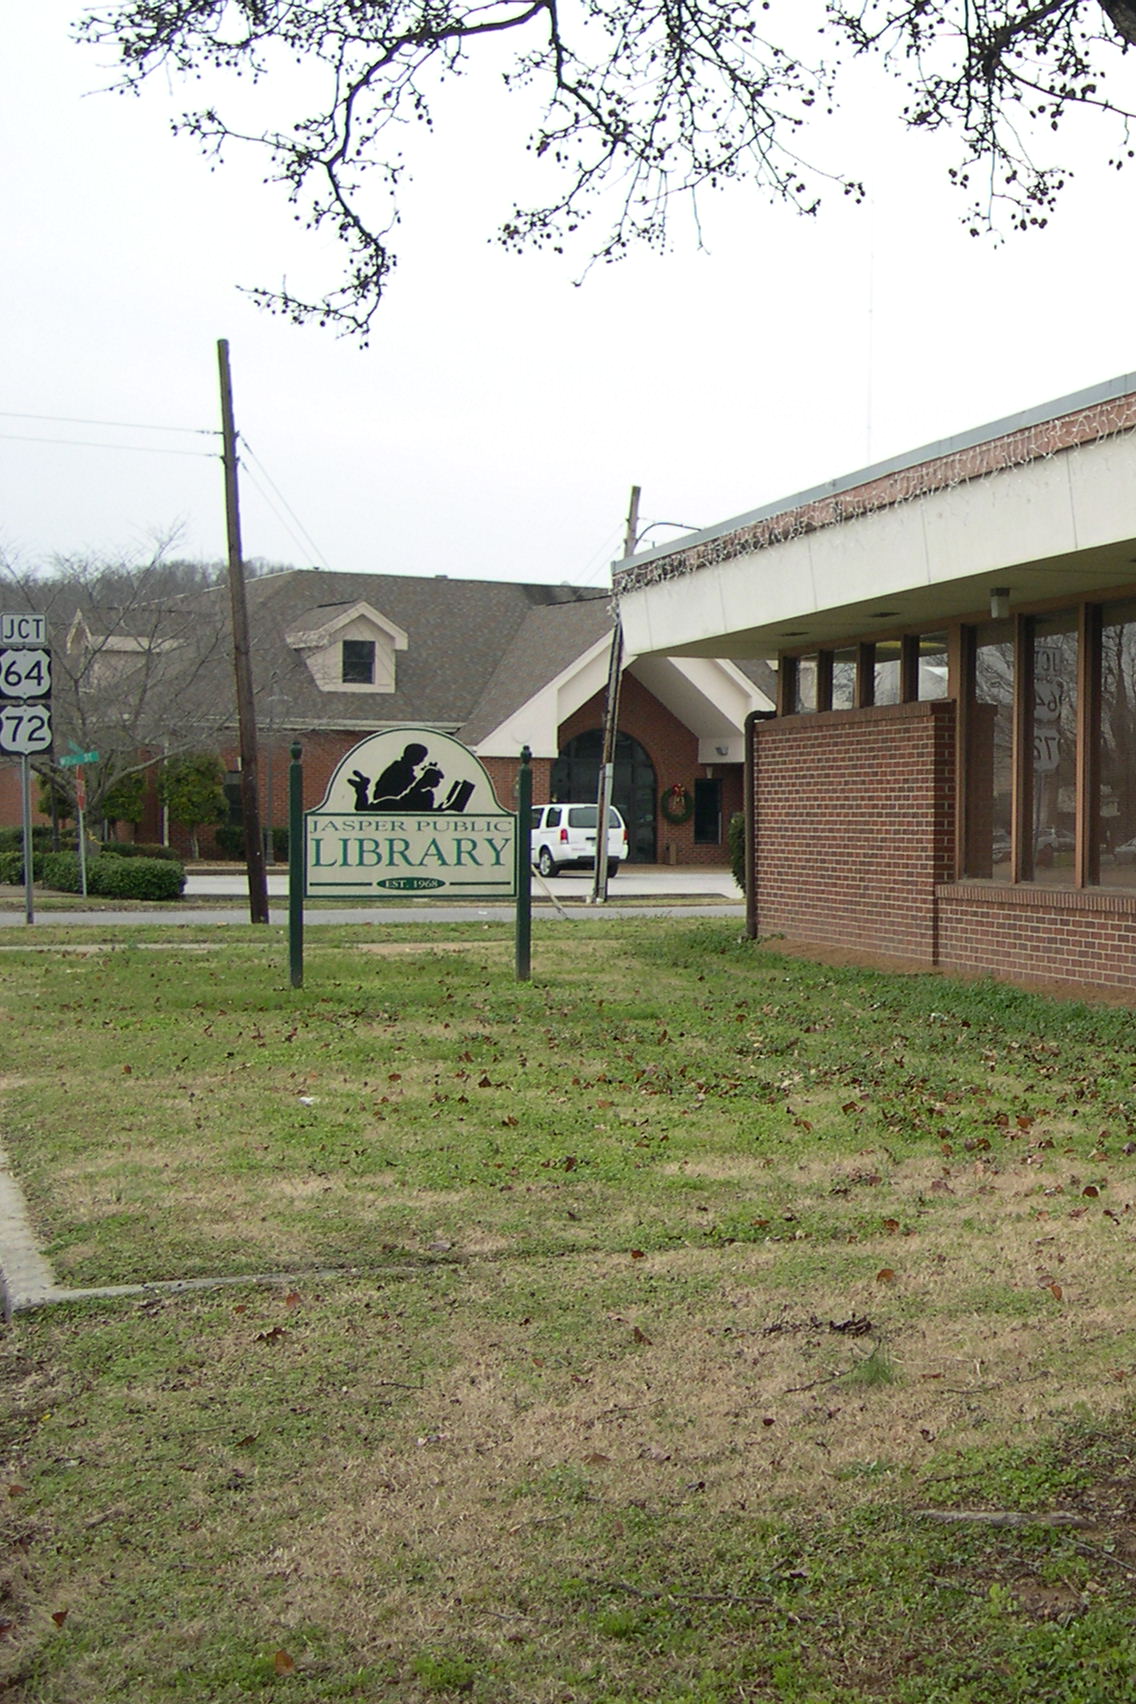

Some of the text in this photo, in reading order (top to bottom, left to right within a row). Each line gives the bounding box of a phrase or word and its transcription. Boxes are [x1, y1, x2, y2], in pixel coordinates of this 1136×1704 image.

[4, 619, 44, 640] JCT
[4, 660, 44, 687] 64
[5, 715, 46, 742] 72
[309, 820, 512, 833] JASPER PUBLIC
[310, 837, 512, 867] LIBRARY
[385, 880, 438, 888] EST. 1968
